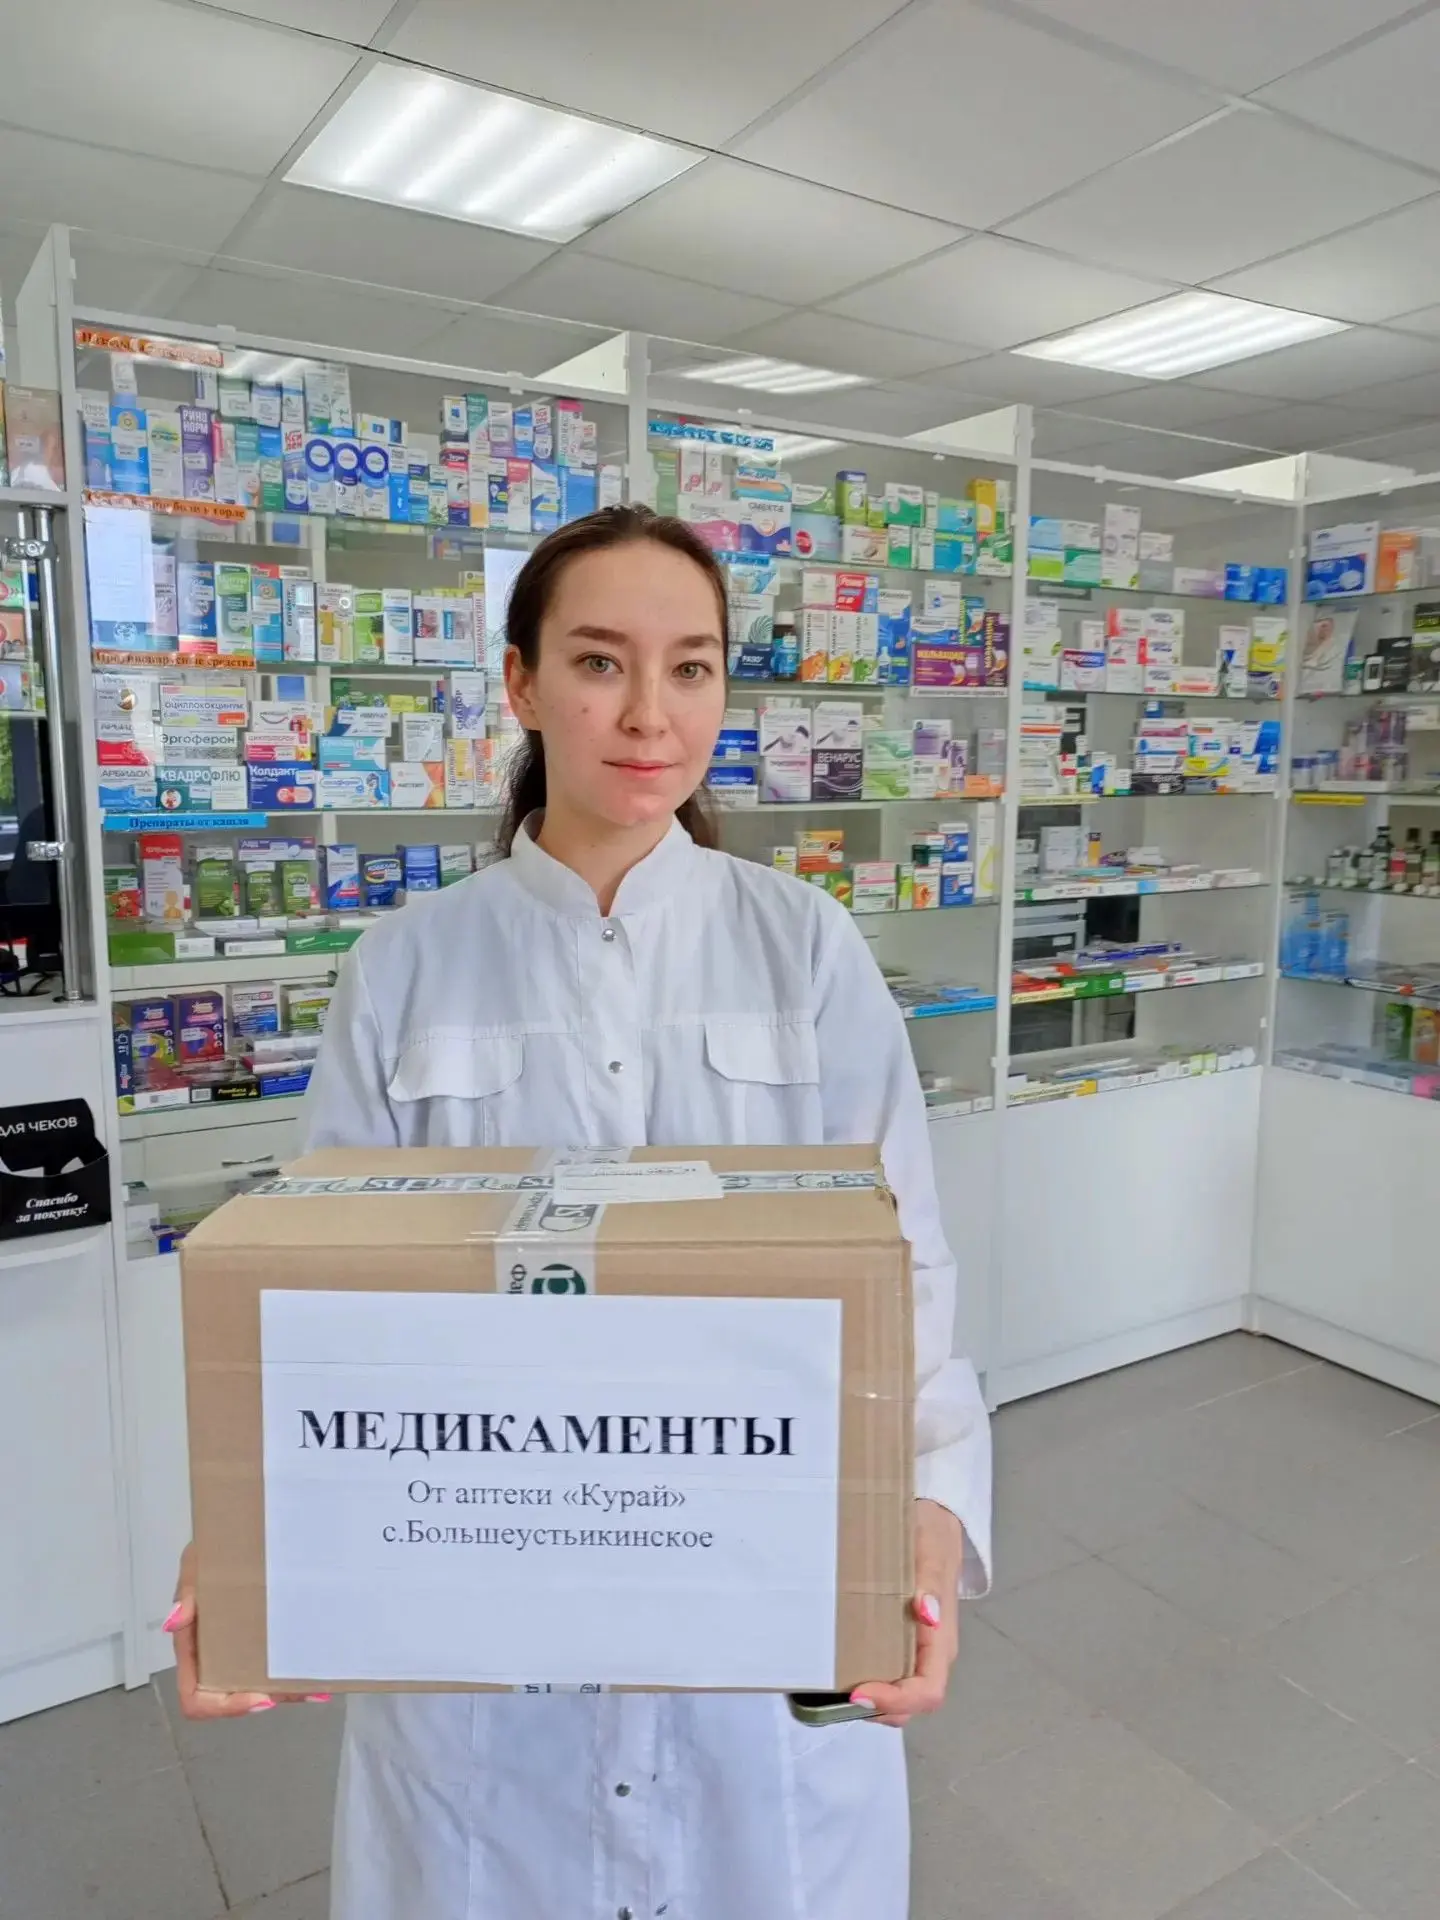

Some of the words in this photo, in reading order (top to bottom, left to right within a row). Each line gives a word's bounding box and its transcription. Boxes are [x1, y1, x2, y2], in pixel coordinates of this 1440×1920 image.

[160, 732, 236, 748] Эргоферон
[816, 752, 861, 764] ВЕНАРУС
[101, 768, 150, 779] АРБИДОЛ
[160, 768, 241, 784] КВАДРОФЛЮ
[129, 816, 195, 831] Препараты
[197, 818, 209, 827] от
[212, 817, 249, 827] кашля
[29, 1116, 78, 1132] ЧЕКОВ
[25, 1193, 79, 1209] Спасибо
[15, 1211, 32, 1224] за
[33, 1204, 89, 1223] покупку!
[296, 1408, 800, 1462] МЕДИКАМЕНТЫ
[407, 1479, 445, 1506] От
[454, 1484, 553, 1508] аптеки
[562, 1480, 687, 1515] «Курай»
[381, 1519, 713, 1552] с.Большеустьикинское
